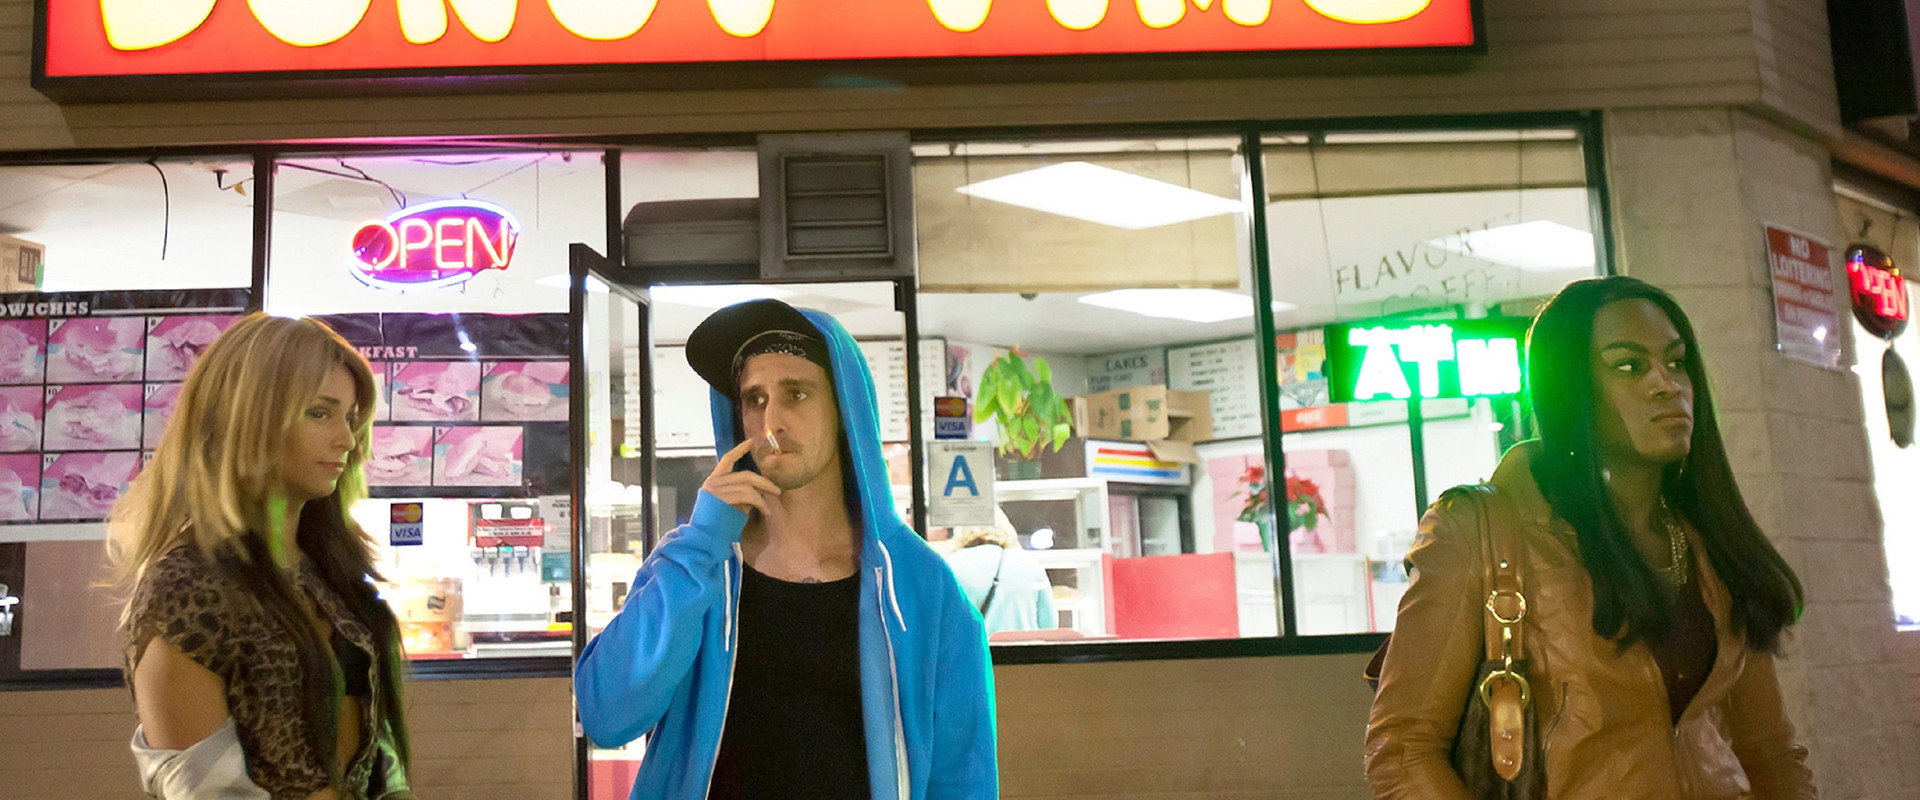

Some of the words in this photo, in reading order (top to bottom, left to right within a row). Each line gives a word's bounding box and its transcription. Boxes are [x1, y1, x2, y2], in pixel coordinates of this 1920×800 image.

[350, 216, 510, 271] OPEN
[1790, 235, 1810, 259] NO
[1106, 355, 1150, 373] CAKES
[1353, 337, 1521, 400] ATM
[939, 421, 966, 431] VISA
[943, 454, 980, 497] A
[394, 527, 422, 539] VISA
